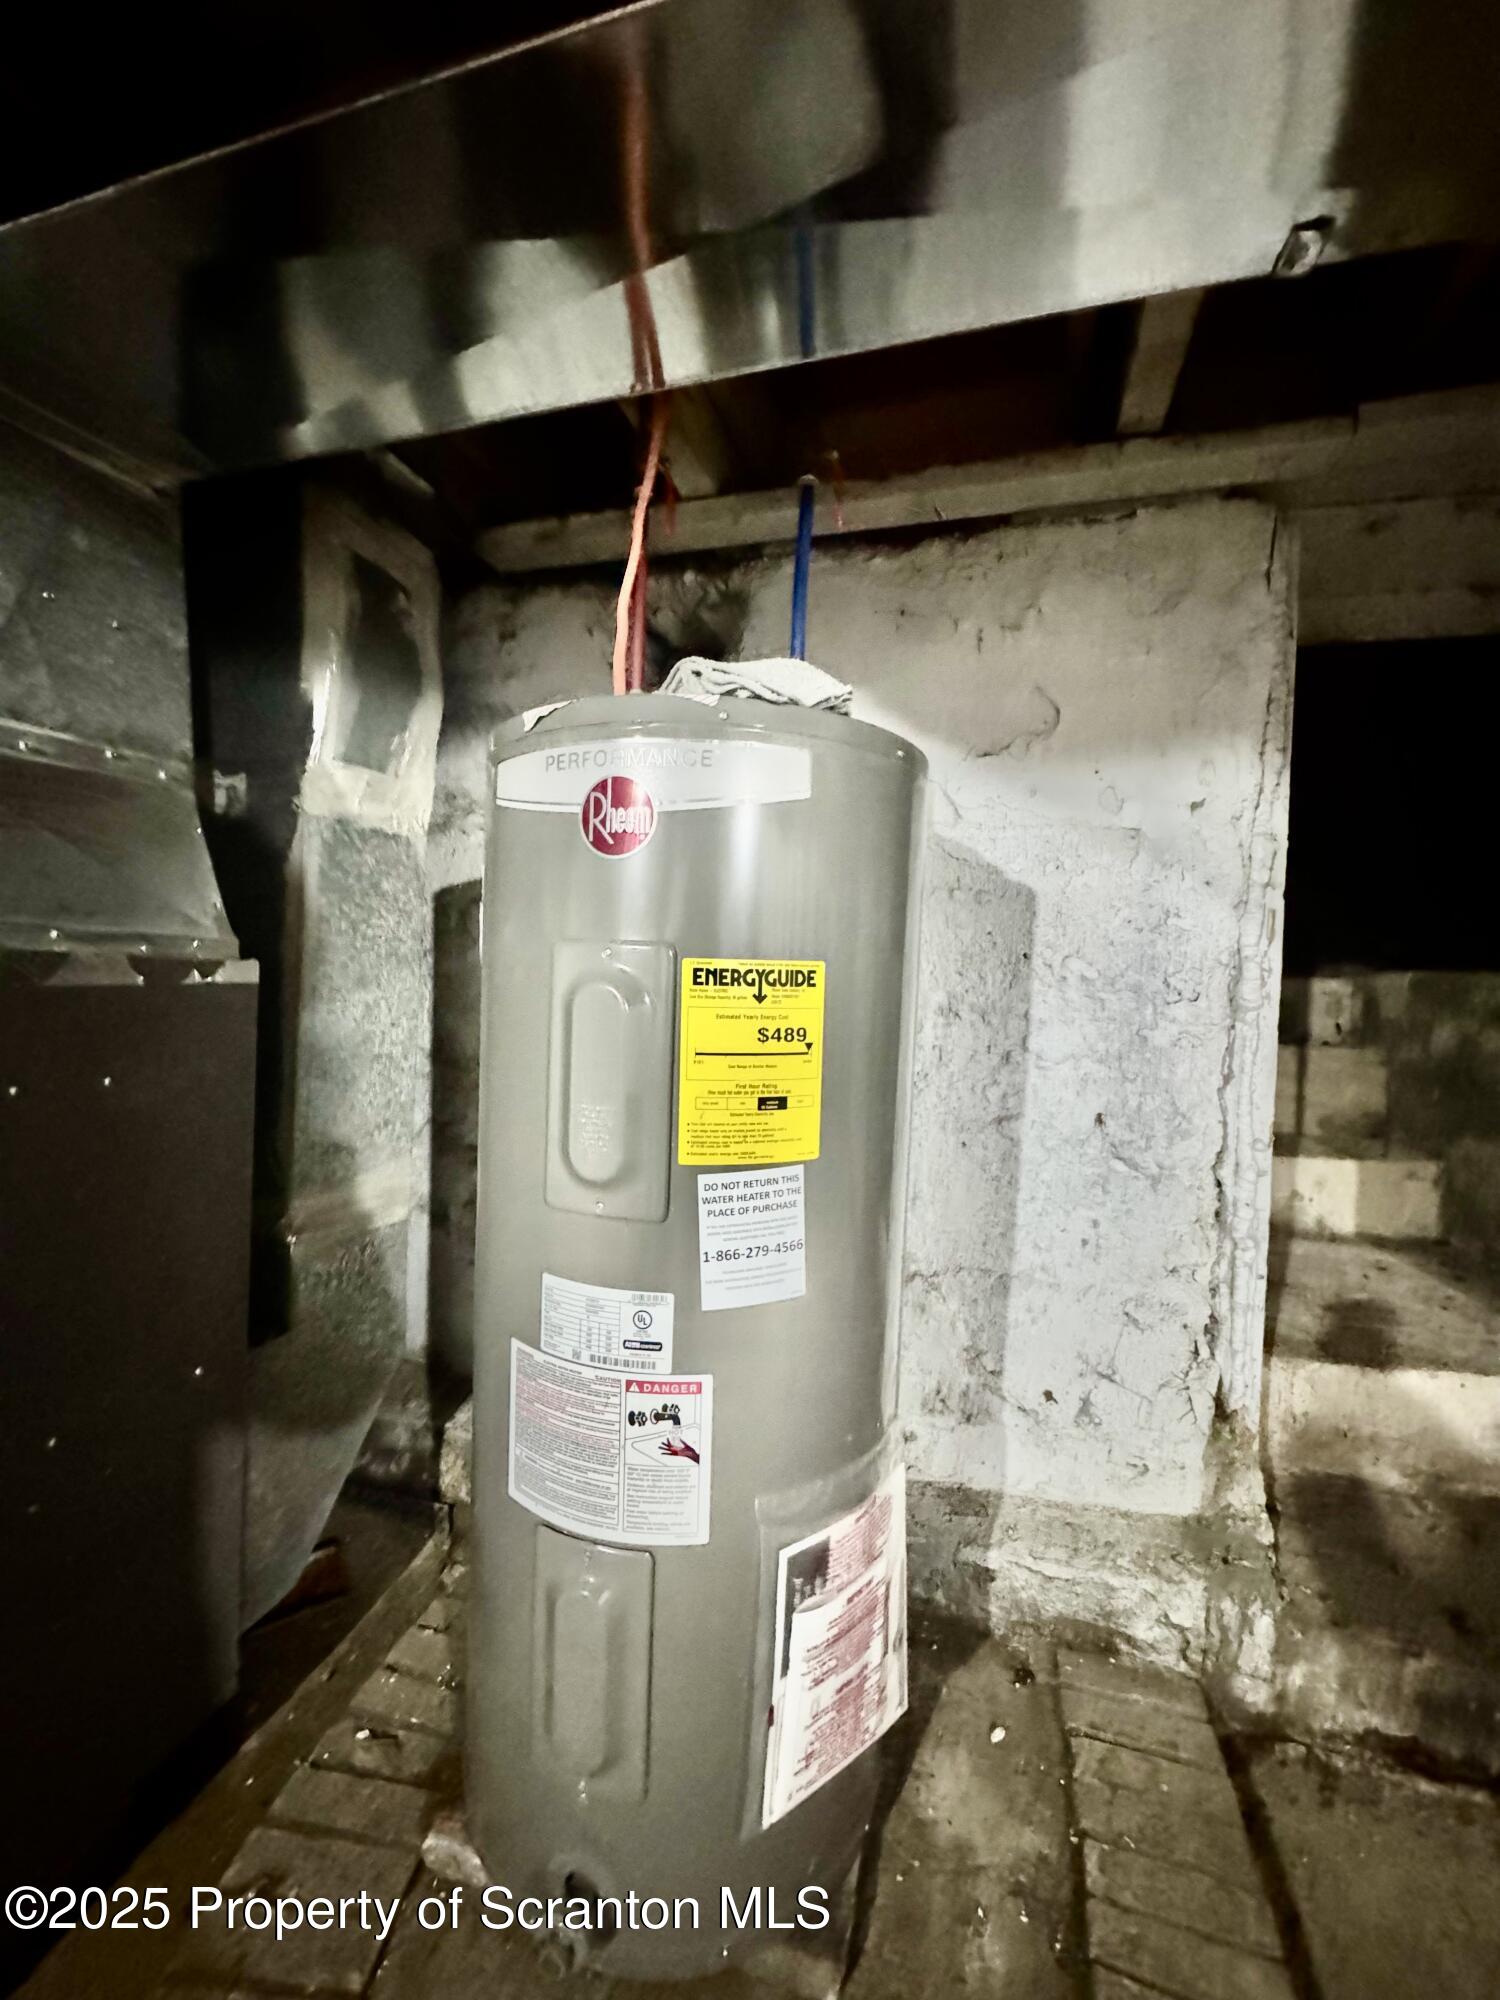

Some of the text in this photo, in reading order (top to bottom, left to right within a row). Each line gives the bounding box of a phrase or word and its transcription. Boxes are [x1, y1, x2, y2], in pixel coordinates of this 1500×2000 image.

[545, 748, 713, 771] PERFORMANCE
[588, 778, 651, 845] Rheem
[692, 967, 817, 988] ENERGYGUIDE
[757, 1027, 807, 1044] $489
[703, 1174, 800, 1192] DO NOT RETURN THIS
[701, 1186, 802, 1205] WATER HEATER TO THE
[707, 1199, 798, 1218] PLACE OF PURCHASE
[703, 1238, 804, 1263] 1-866-279-4566
[643, 1383, 698, 1394] DANGER
